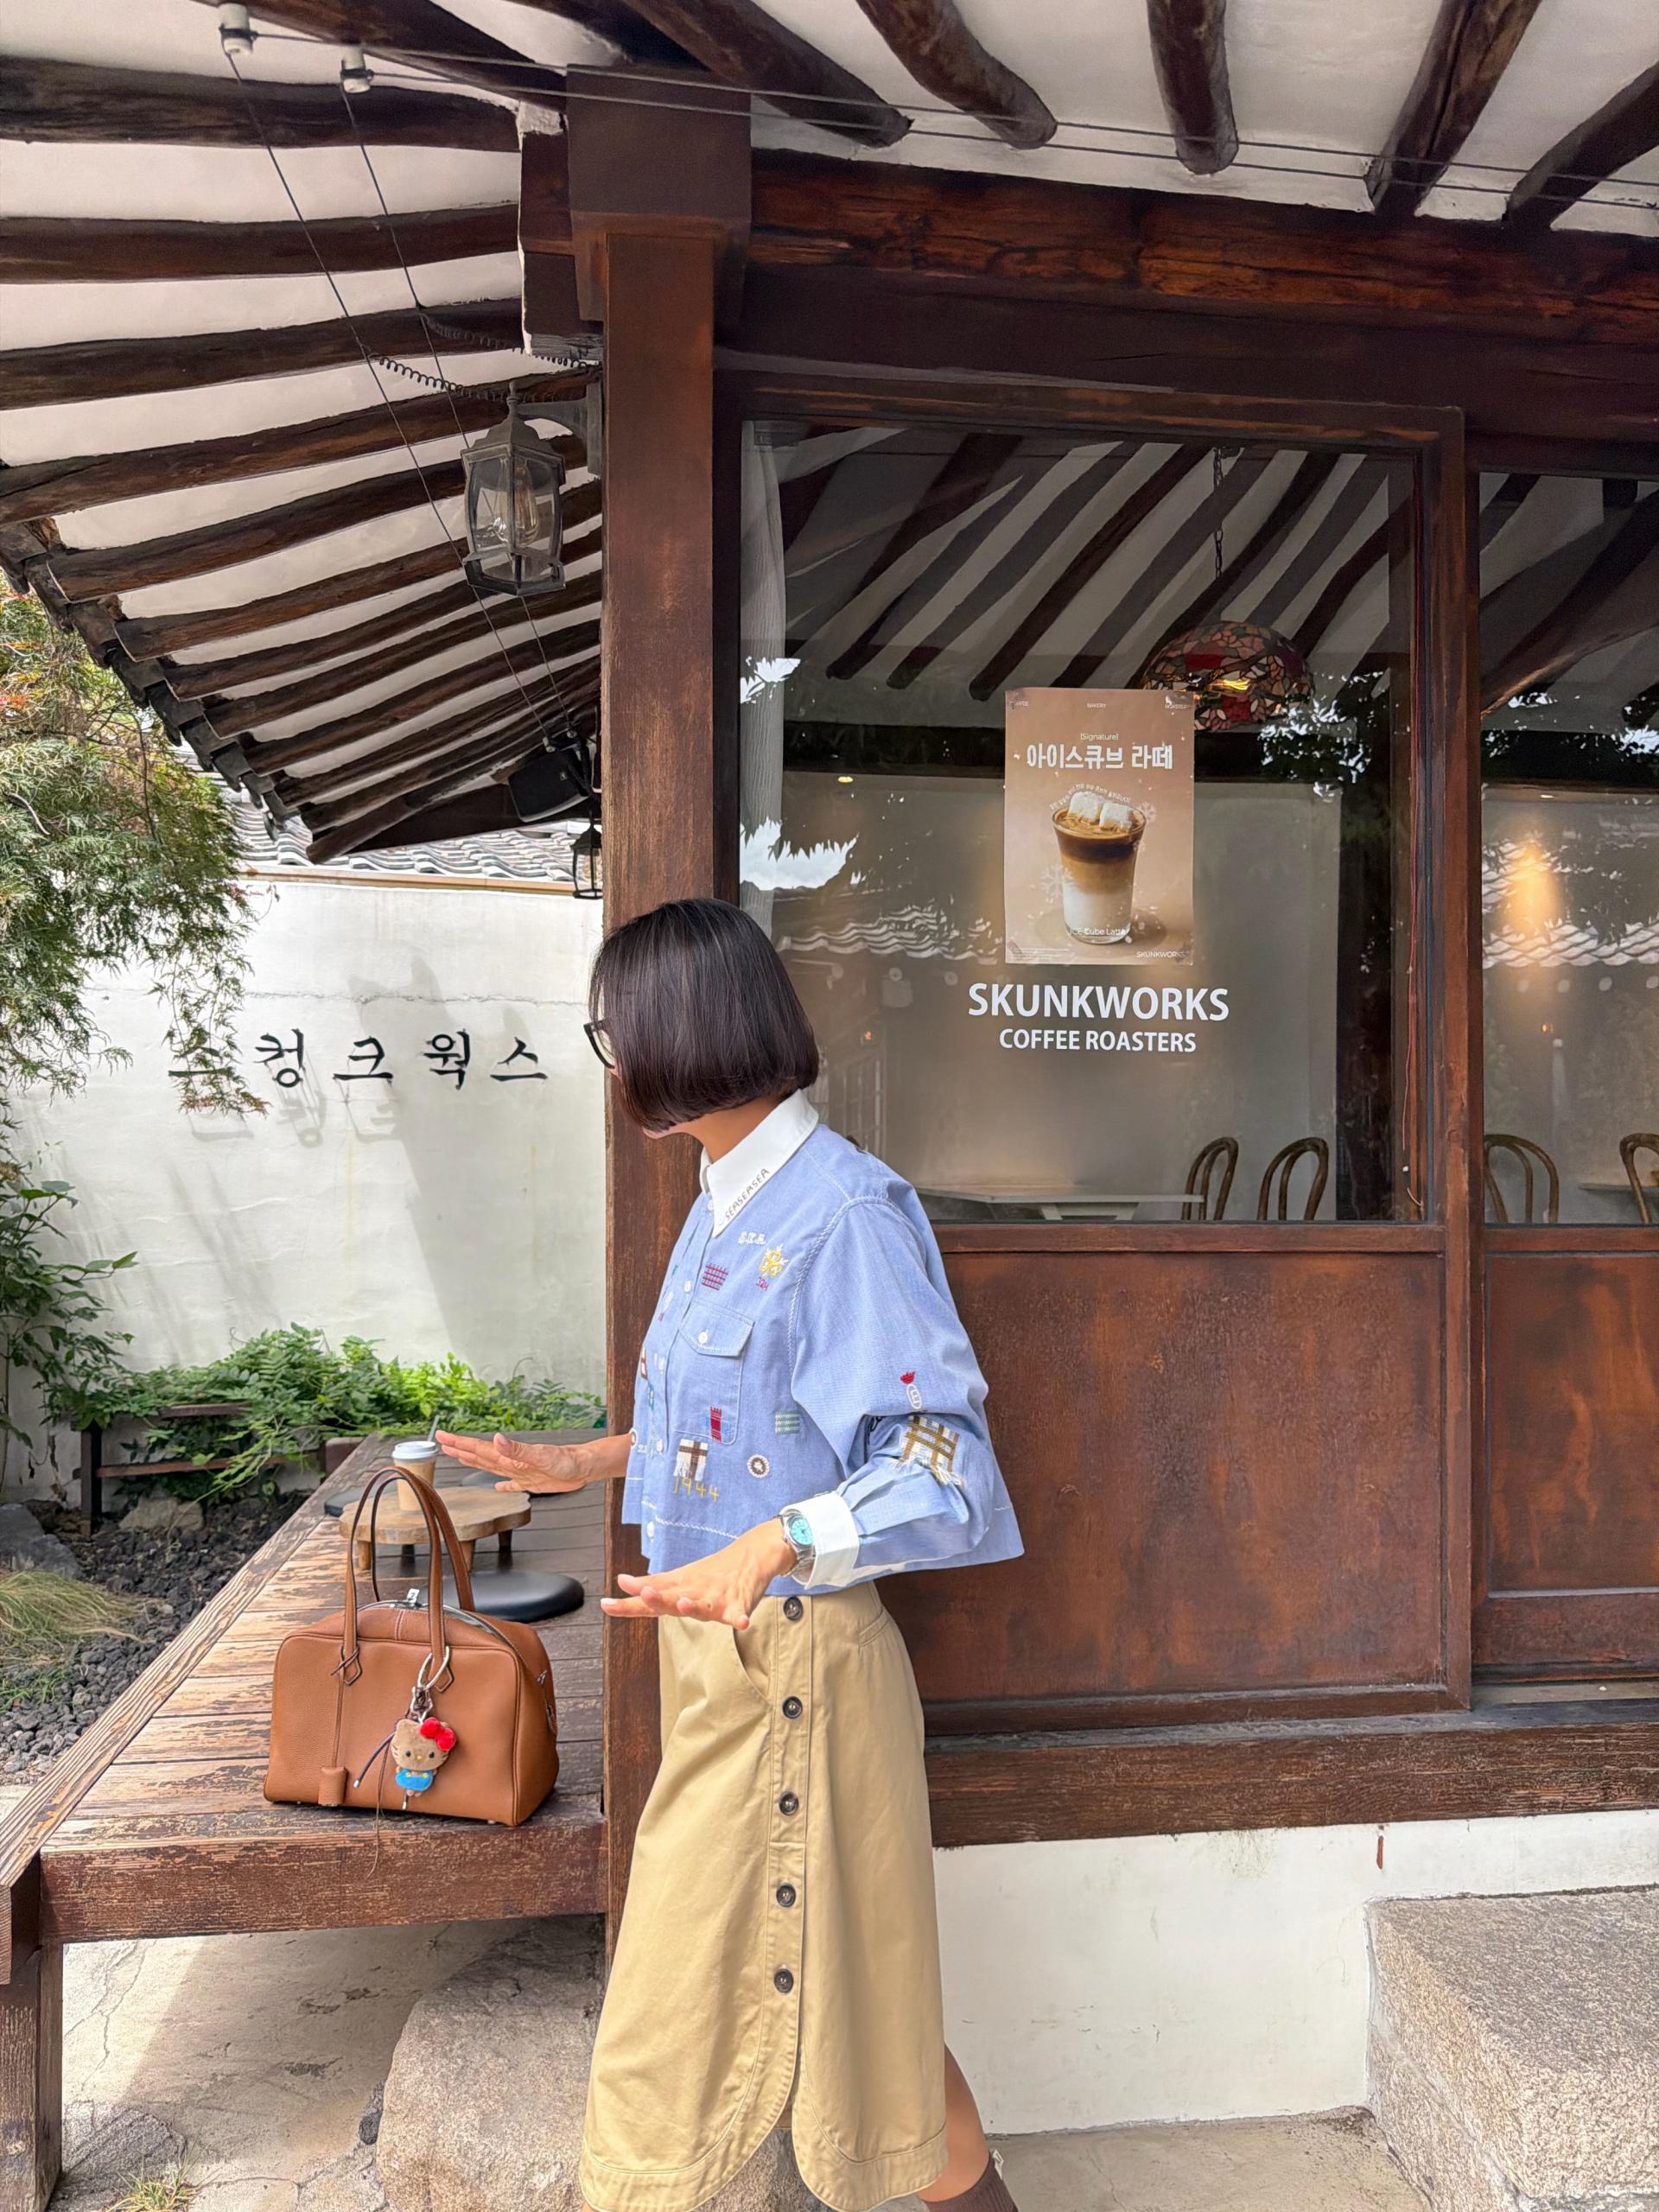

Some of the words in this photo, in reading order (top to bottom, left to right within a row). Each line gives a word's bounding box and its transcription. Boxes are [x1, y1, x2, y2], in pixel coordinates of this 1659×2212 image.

[1027, 743, 1124, 769] 아이스큐브
[1131, 744, 1173, 769] 라떼
[1084, 927, 1105, 936] Cube
[968, 982, 1230, 1021] SKUNKWORKS
[999, 1028, 1080, 1050] COFFEE
[1085, 1030, 1197, 1052] ROASTERS
[725, 1168, 770, 1221] SEASEASEA
